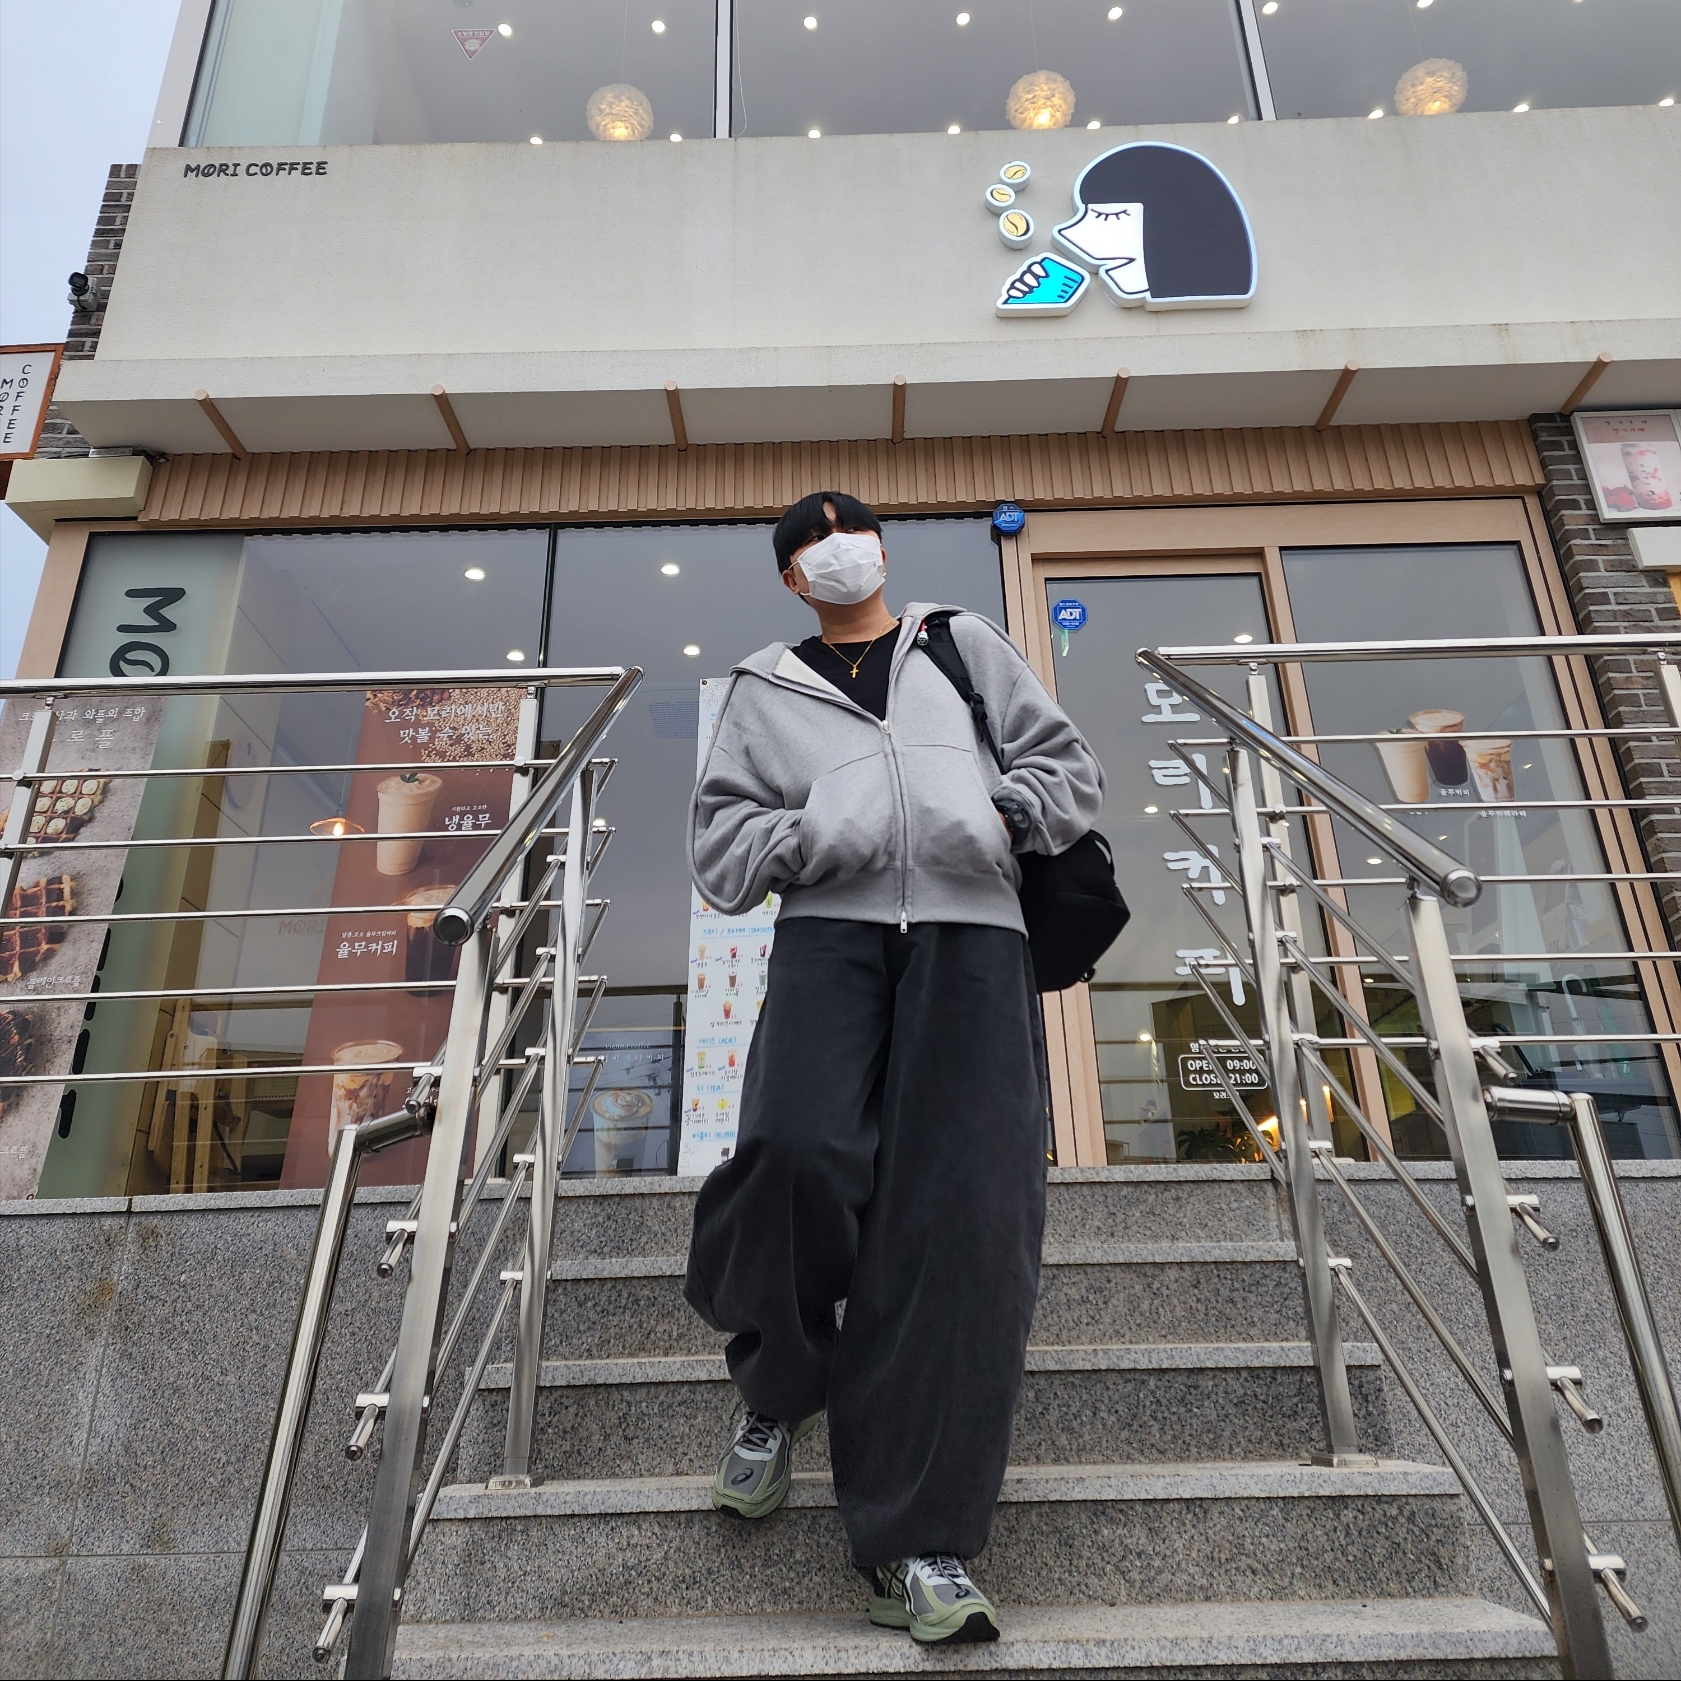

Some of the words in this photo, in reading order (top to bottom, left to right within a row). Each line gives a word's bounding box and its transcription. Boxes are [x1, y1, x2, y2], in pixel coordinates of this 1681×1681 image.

[184, 162, 240, 178] MORI
[245, 161, 328, 176] COFFEE
[3, 364, 32, 444] COFFEE
[999, 511, 1020, 522] ADT
[1058, 608, 1082, 620] ADT
[82, 707, 119, 724] 와플의
[123, 706, 146, 722] 조합
[384, 706, 418, 723] 오직
[424, 701, 505, 720] 모리에서만
[399, 726, 431, 744] 맛볼
[438, 726, 454, 741] 수
[461, 723, 493, 740] 있는
[444, 813, 492, 831] 냉율무
[336, 940, 398, 959] 율무커피
[1228, 1073, 1259, 1084] 21:00
